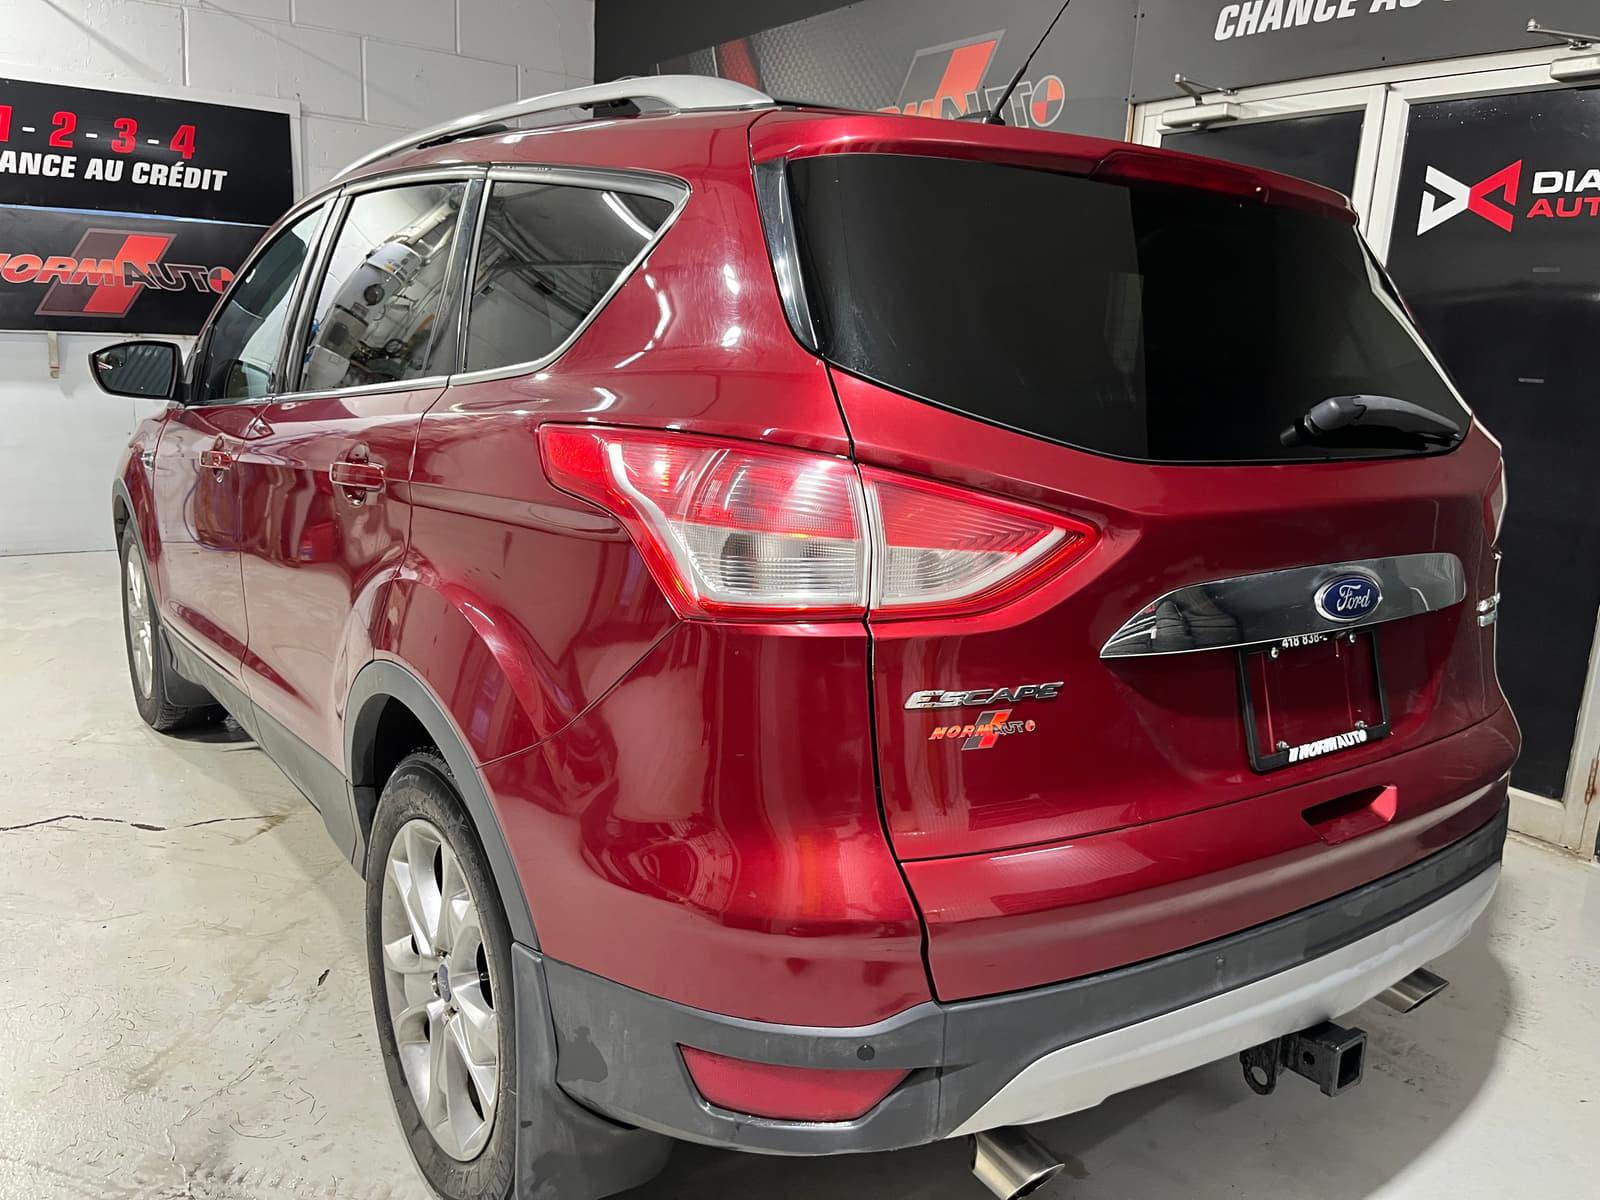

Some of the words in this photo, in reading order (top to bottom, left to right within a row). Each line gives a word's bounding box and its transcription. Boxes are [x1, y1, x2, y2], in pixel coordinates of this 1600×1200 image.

[49, 111, 77, 148] 2
[111, 118, 138, 153] 3
[169, 124, 197, 160] 4
[84, 158, 124, 182] AU
[131, 161, 228, 191] CRÉDIT
[1336, 584, 1371, 612] Ford
[904, 681, 1065, 710] ESCAPE
